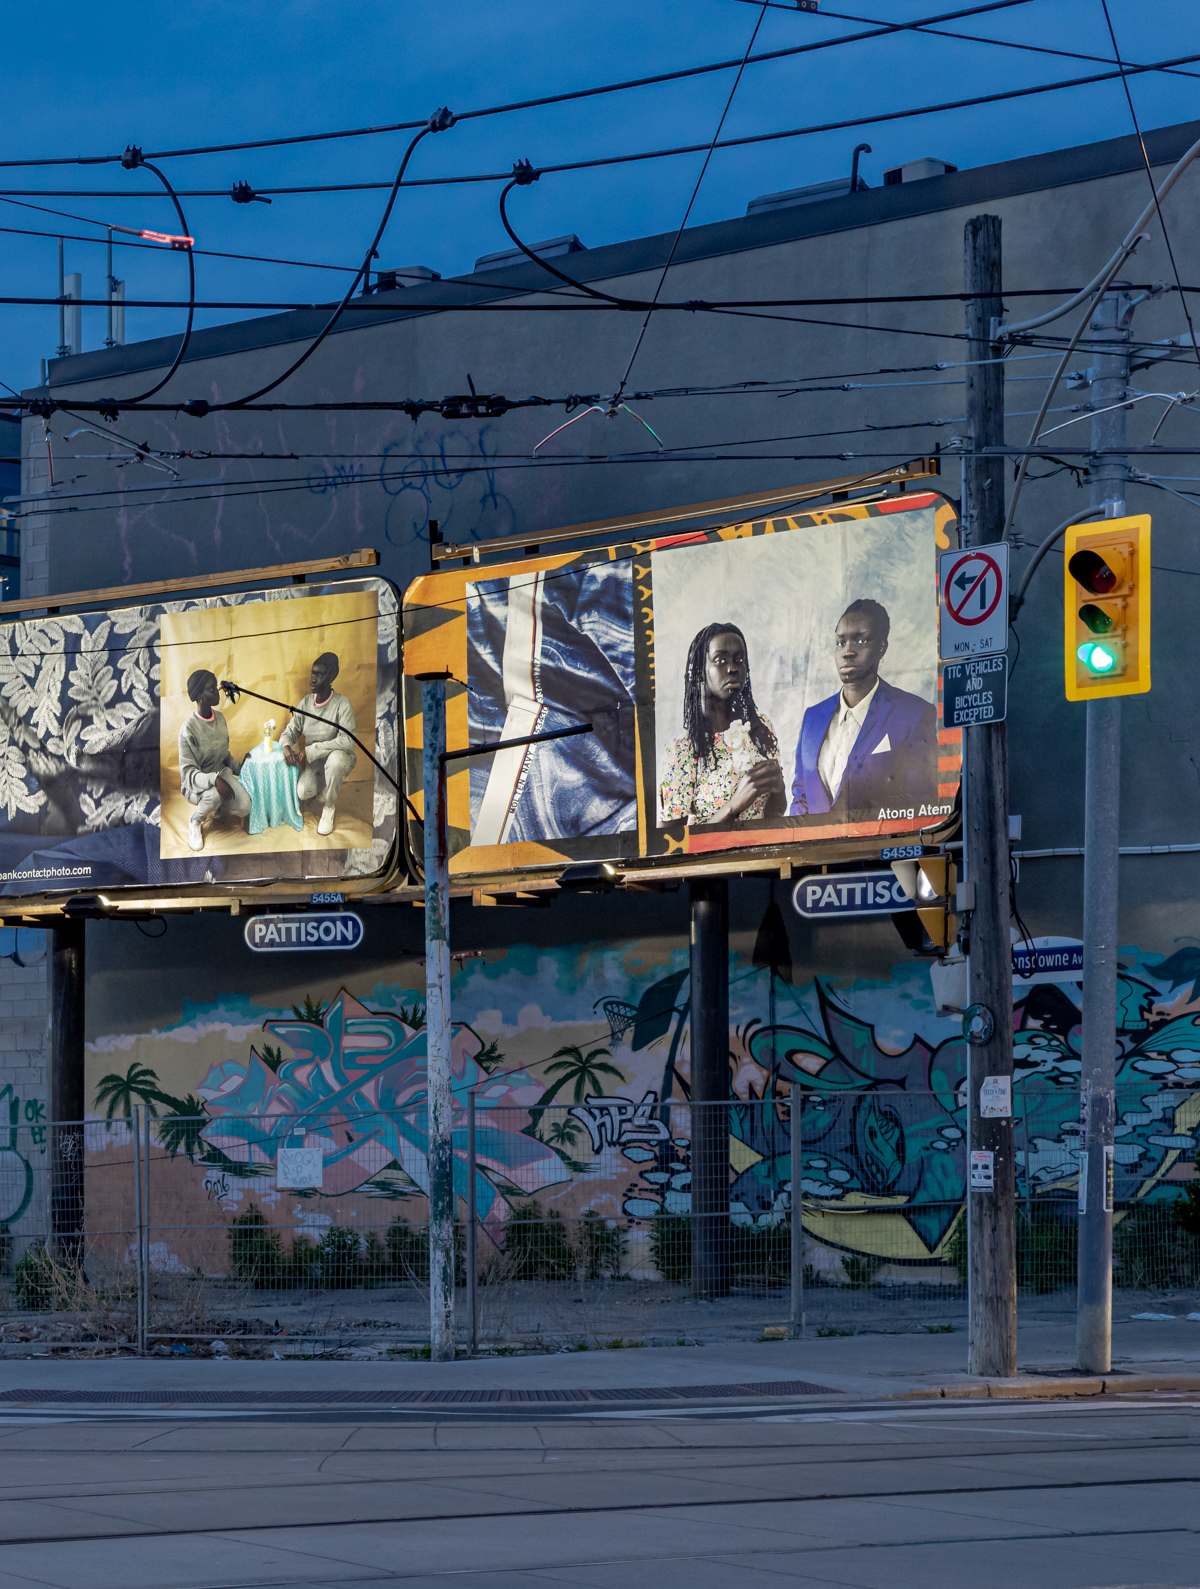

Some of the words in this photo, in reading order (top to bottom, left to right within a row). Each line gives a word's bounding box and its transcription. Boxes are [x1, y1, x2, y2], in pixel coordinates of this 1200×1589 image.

[954, 641, 970, 653] MON
[979, 637, 993, 650] SAT
[947, 665, 962, 680] TTC
[965, 658, 1003, 676] VEHICLES
[965, 677, 983, 692] AND
[955, 691, 993, 709] BICYCLES
[953, 705, 994, 724] EXCEPTED
[521, 750, 534, 775] NAVY
[877, 807, 915, 821] Atong
[918, 804, 952, 818] Atem
[882, 845, 922, 860] 5455B
[312, 893, 343, 904] 5455A
[806, 880, 910, 908] PATTISO
[254, 921, 353, 943] PATTISON
